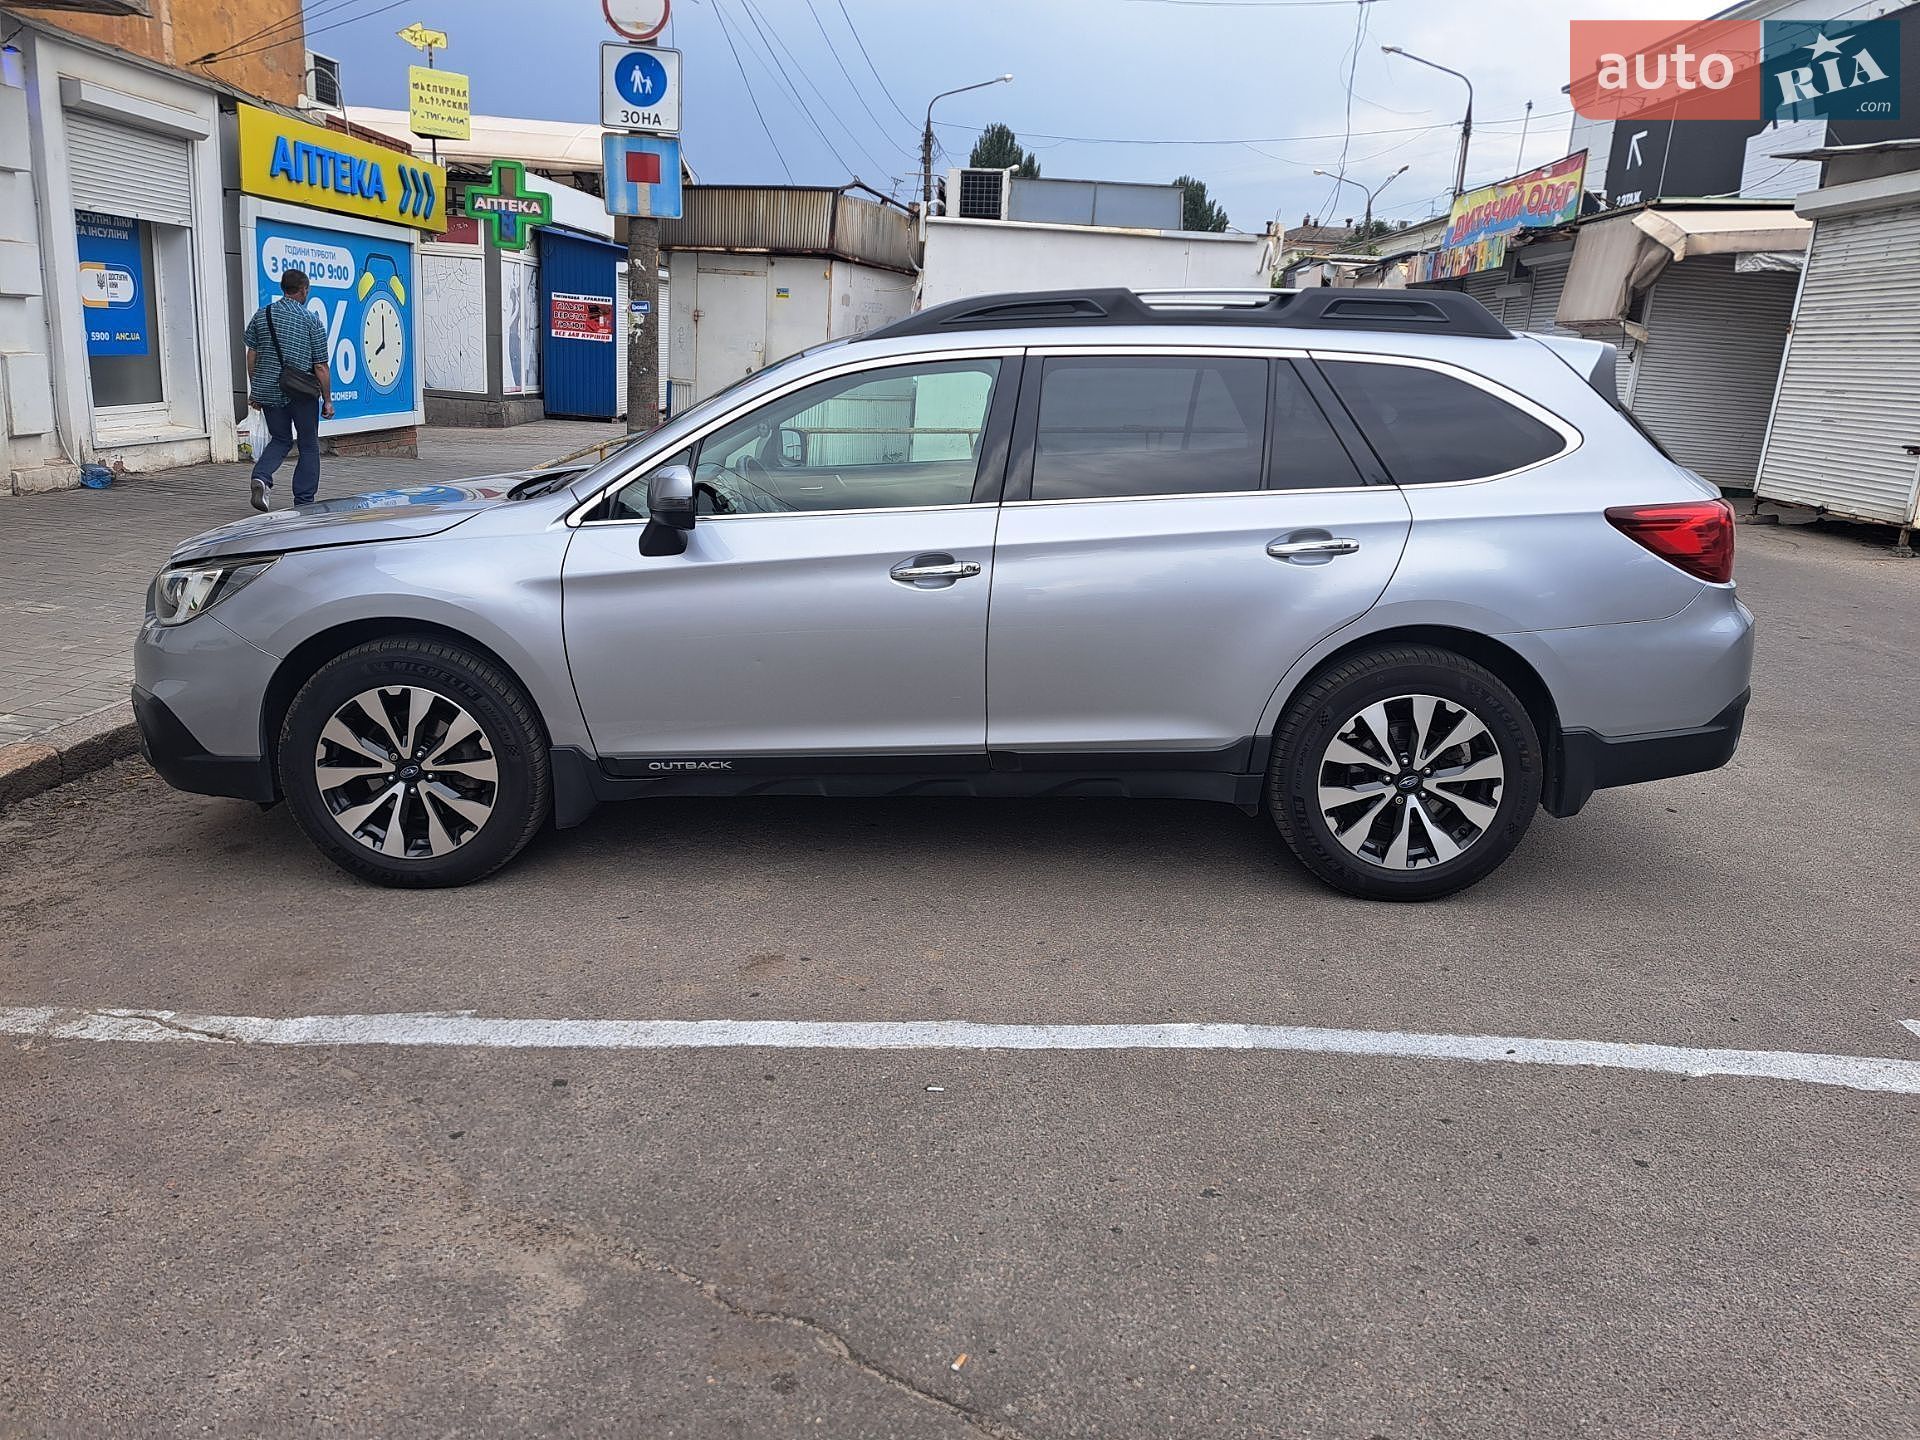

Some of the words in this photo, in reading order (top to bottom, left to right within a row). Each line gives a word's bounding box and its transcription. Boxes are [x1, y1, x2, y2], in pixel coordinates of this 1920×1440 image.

[620, 110, 662, 126] ЗОНА
[270, 135, 387, 203] АПТЕКА
[474, 197, 542, 215] АПТЕКА
[1451, 183, 1526, 244] ДИТЯЧИЙ
[1526, 181, 1578, 217] ОДЯГ
[88, 226, 129, 240] ІНСУЛІНИ
[284, 244, 309, 257] ГОДИНИ
[310, 249, 336, 261] ТУРБОТИ
[282, 258, 306, 274] 8:00
[309, 261, 325, 281] ДО
[327, 264, 349, 281] 9:00
[91, 331, 110, 341] 5900
[391, 661, 482, 703] MICHELIN
[647, 761, 733, 770] OUTBACK
